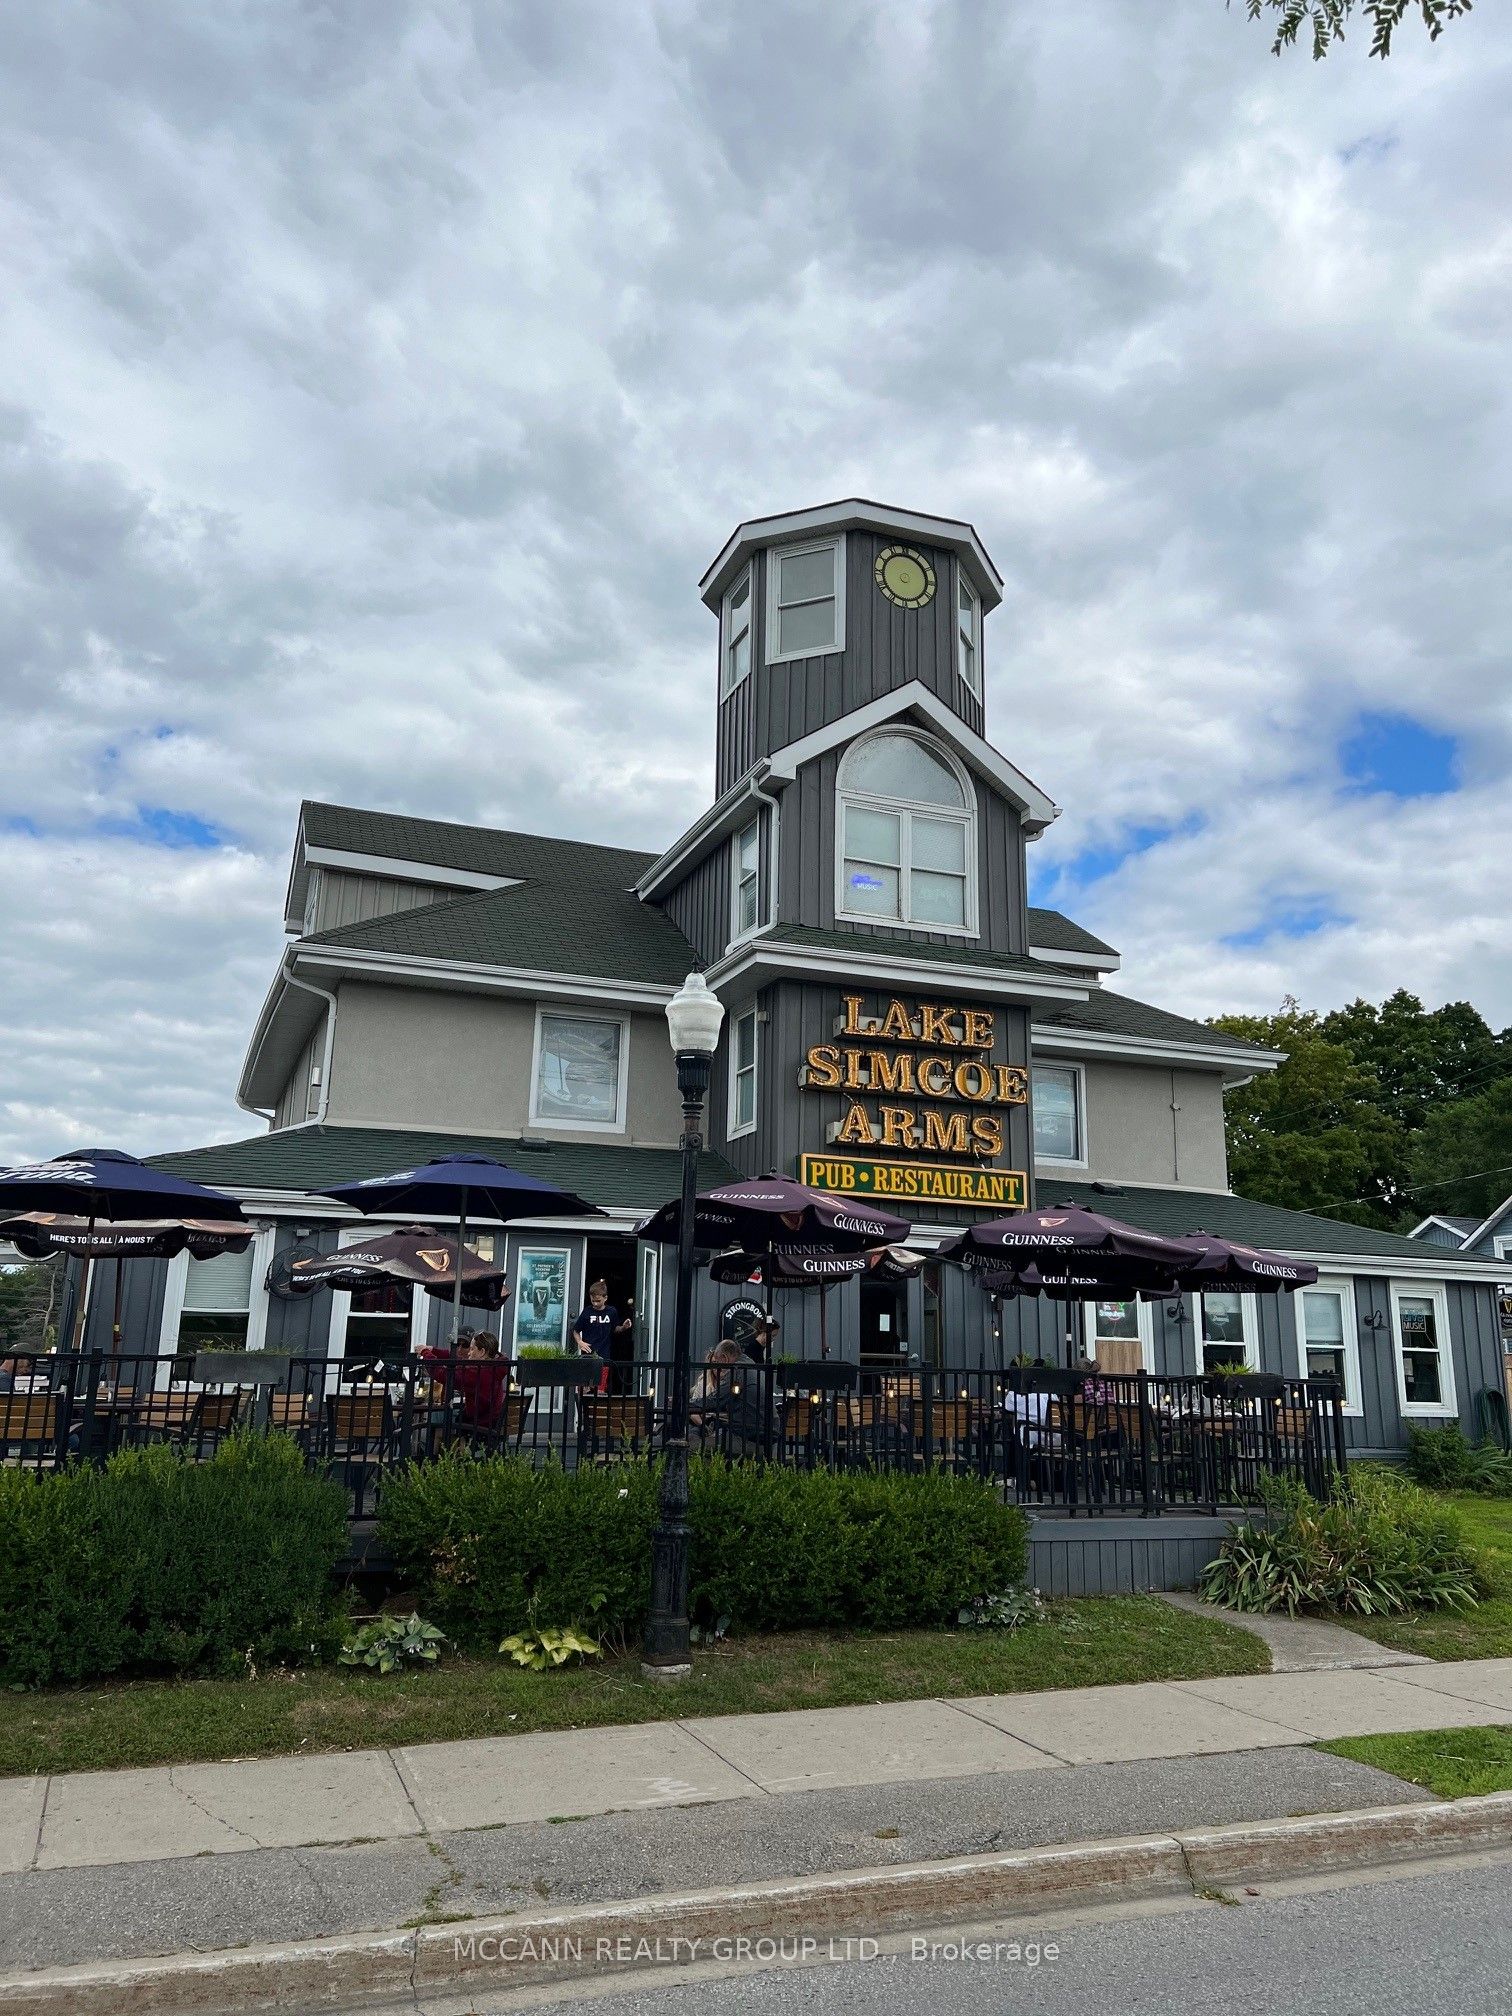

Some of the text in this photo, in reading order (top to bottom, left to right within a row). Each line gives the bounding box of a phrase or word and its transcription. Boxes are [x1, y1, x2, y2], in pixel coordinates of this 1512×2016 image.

[841, 996, 995, 1049] LAKE
[806, 1044, 1029, 1104] SIMCOE
[835, 1103, 1004, 1156] ARMS
[810, 1161, 1019, 1202] PUB RESTAURANT
[833, 1212, 886, 1236] GUINNESS
[50, 1233, 75, 1244] HERE'S
[77, 1235, 87, 1244] TO
[99, 1236, 113, 1244] ALL
[125, 1236, 145, 1244] NOUS
[1002, 1232, 1075, 1246] GUINNESS
[803, 1259, 866, 1273] GUINNESS
[963, 1251, 1012, 1271] GUINNESS
[1252, 1260, 1298, 1279] GUINNESS
